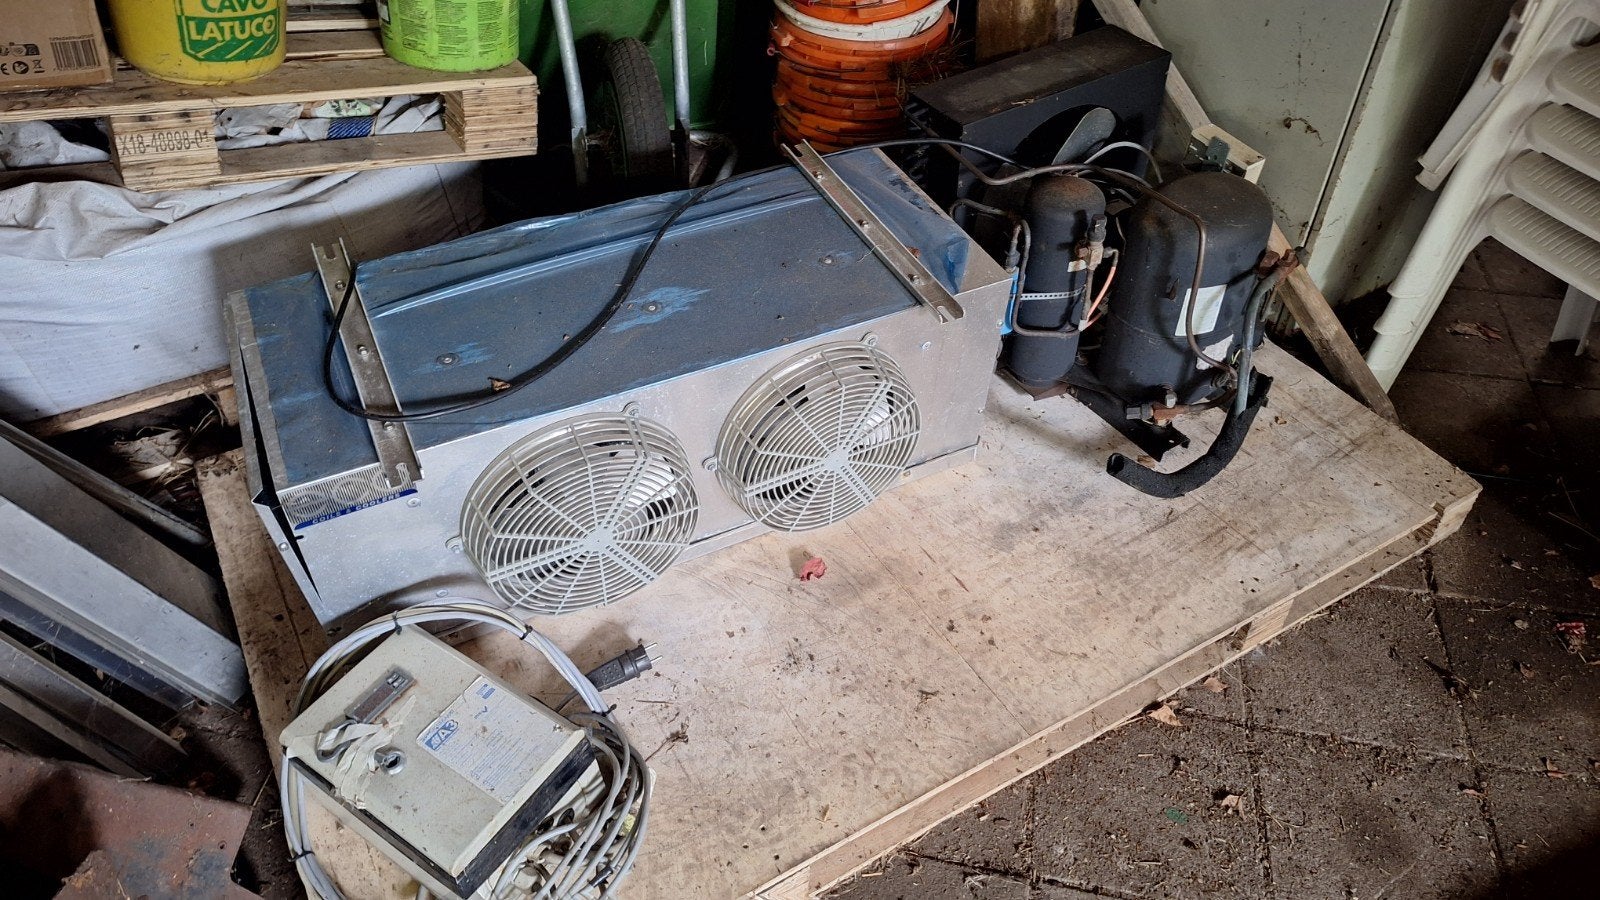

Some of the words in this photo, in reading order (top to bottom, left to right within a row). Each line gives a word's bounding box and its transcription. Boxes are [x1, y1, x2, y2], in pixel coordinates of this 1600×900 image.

[201, 0, 268, 13] CAVO
[188, 15, 276, 41] LATUCO
[313, 511, 341, 524] COILS
[356, 494, 400, 510] COOLERS
